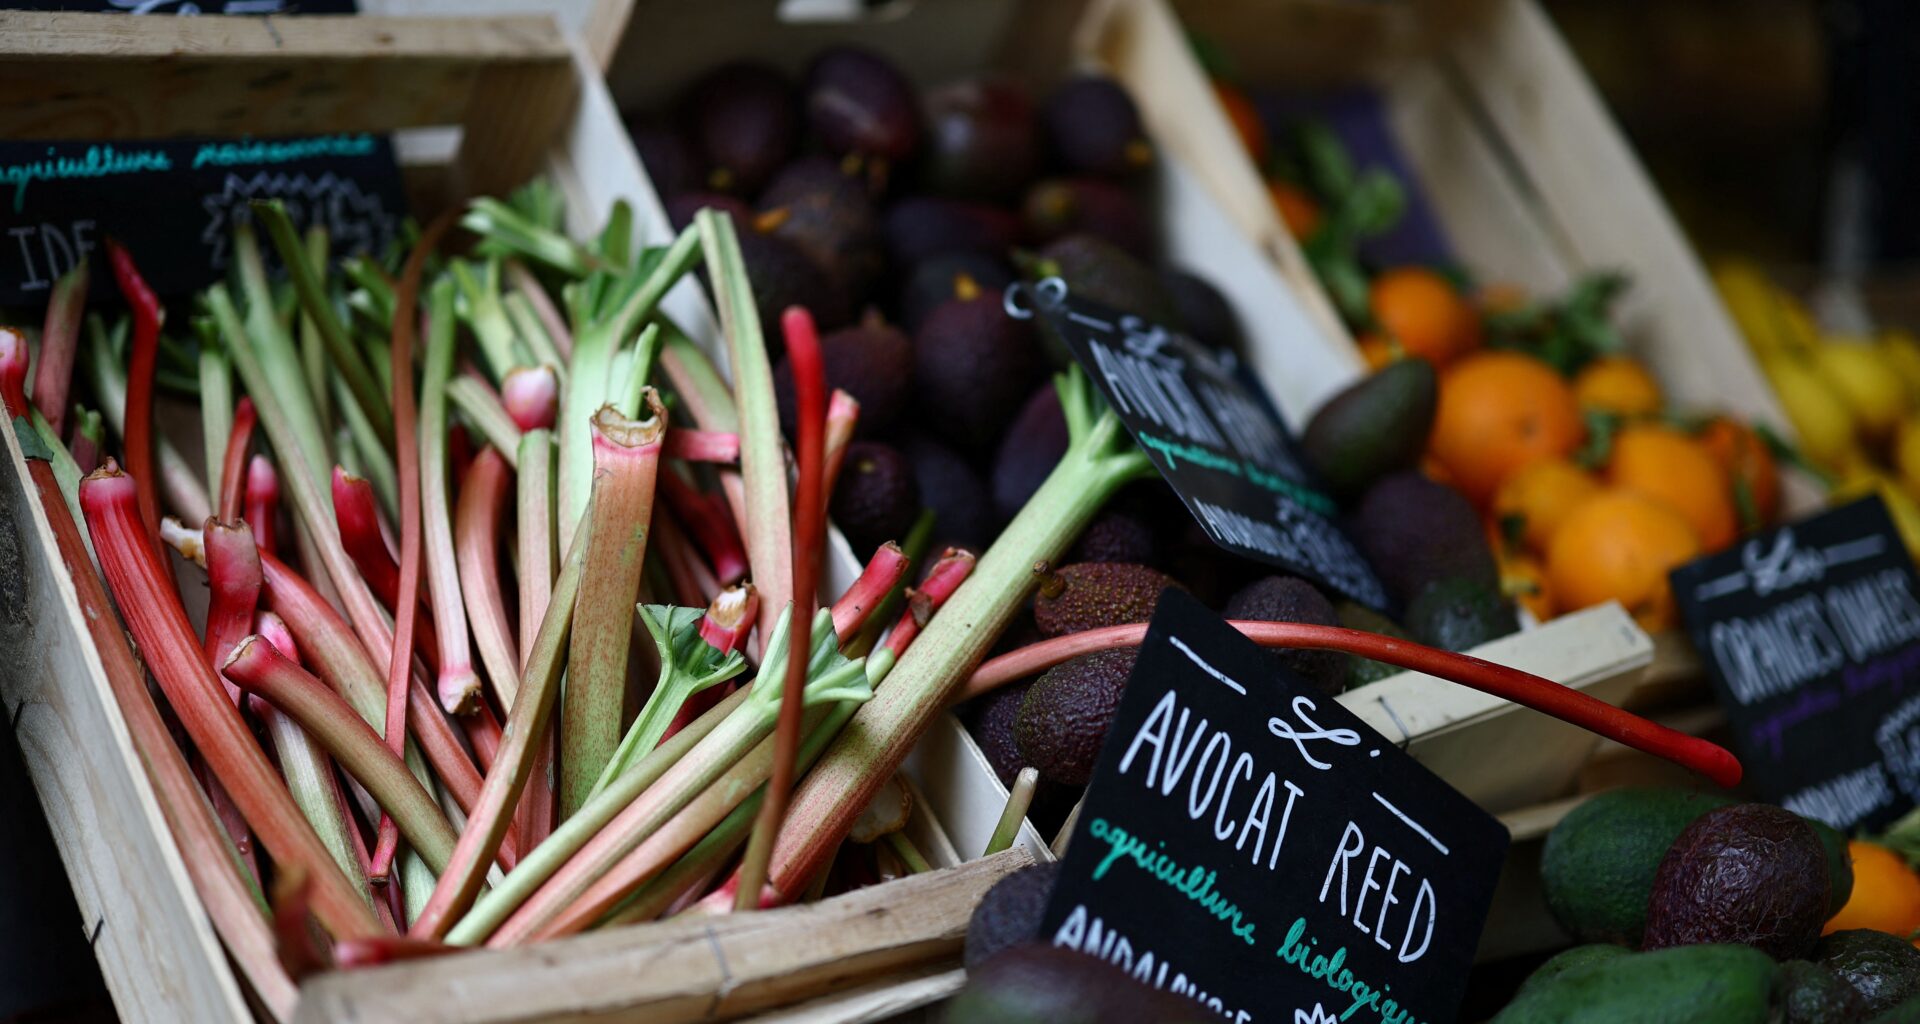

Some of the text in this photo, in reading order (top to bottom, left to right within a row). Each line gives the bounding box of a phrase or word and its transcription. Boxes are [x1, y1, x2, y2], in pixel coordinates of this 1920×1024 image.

[0, 143, 172, 214] griculture
[1089, 818, 1429, 1024] agriculture biologiq
[1118, 690, 1437, 963] AVOCAT REED
